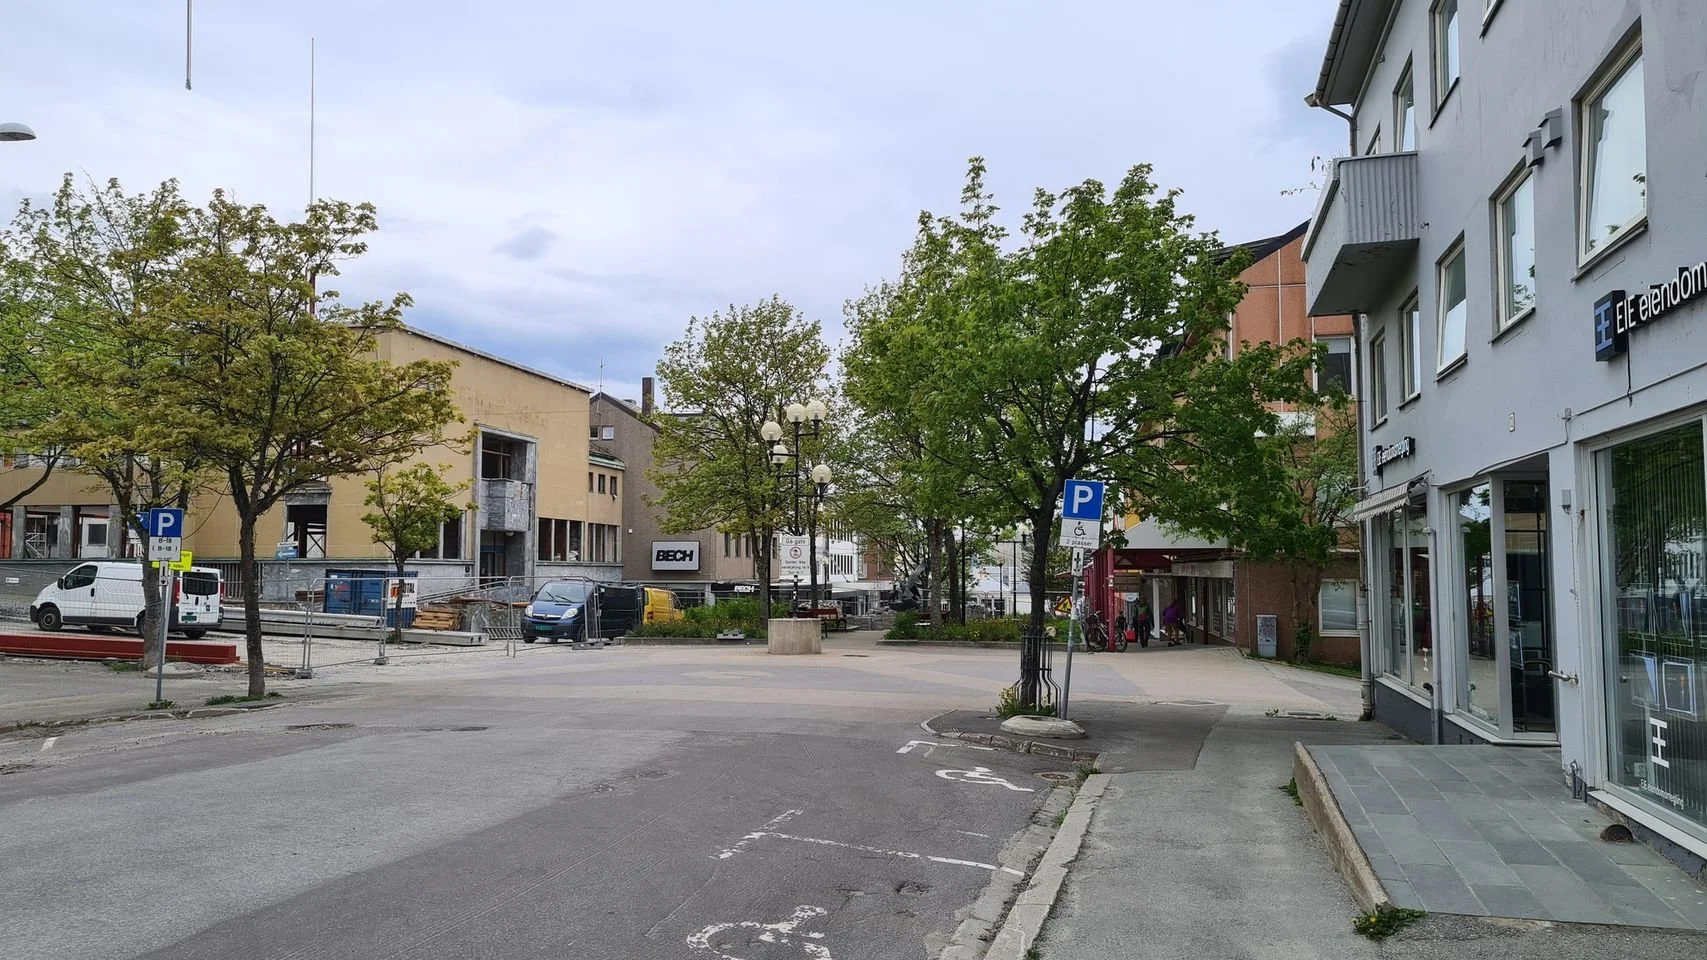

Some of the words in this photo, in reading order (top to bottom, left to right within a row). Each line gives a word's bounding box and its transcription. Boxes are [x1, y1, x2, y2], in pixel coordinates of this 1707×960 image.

[1616, 294, 1636, 334] EIE
[1073, 485, 1093, 513] P
[158, 512, 175, 536] P
[1072, 539, 1092, 547] plasser
[656, 550, 694, 561] BECH
